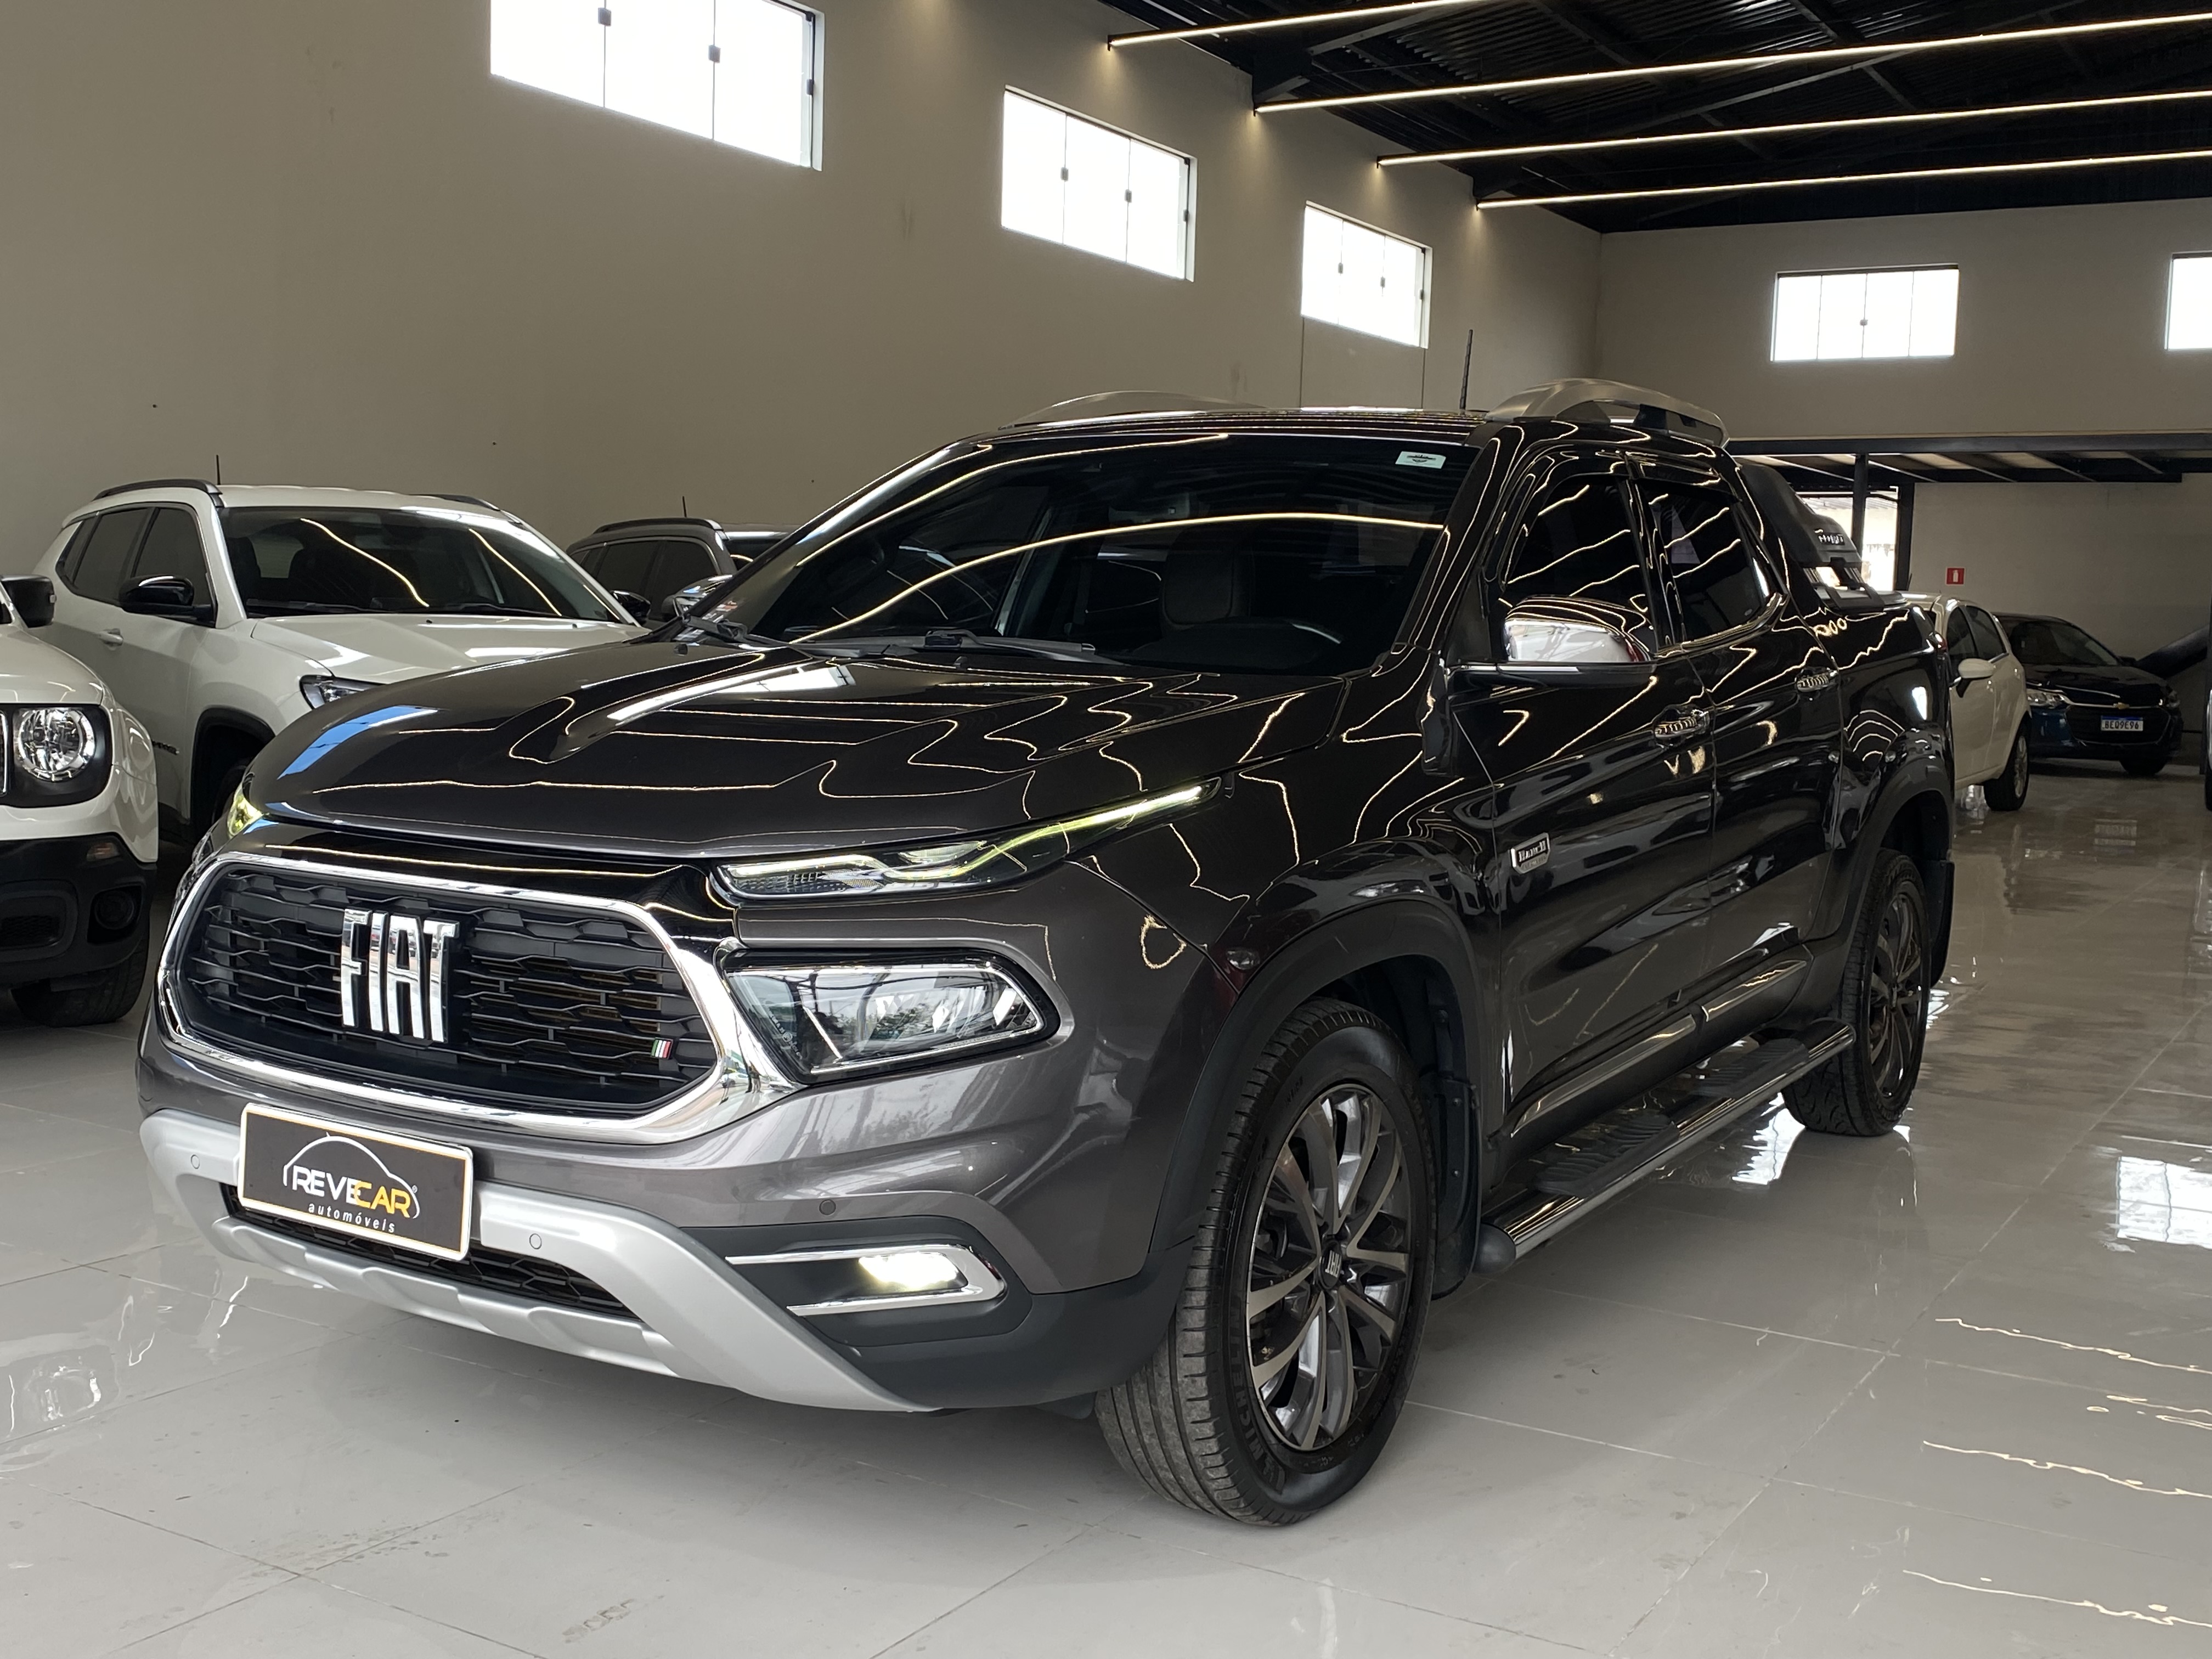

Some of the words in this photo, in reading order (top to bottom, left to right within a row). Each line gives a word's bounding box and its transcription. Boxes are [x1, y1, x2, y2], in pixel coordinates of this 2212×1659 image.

[341, 908, 460, 1043] FIAT
[292, 1165, 411, 1218] REVECAR
[308, 1201, 396, 1233] automóveis
[1325, 1250, 1342, 1278] FIAT
[1229, 1307, 1265, 1460] MICHELIN
